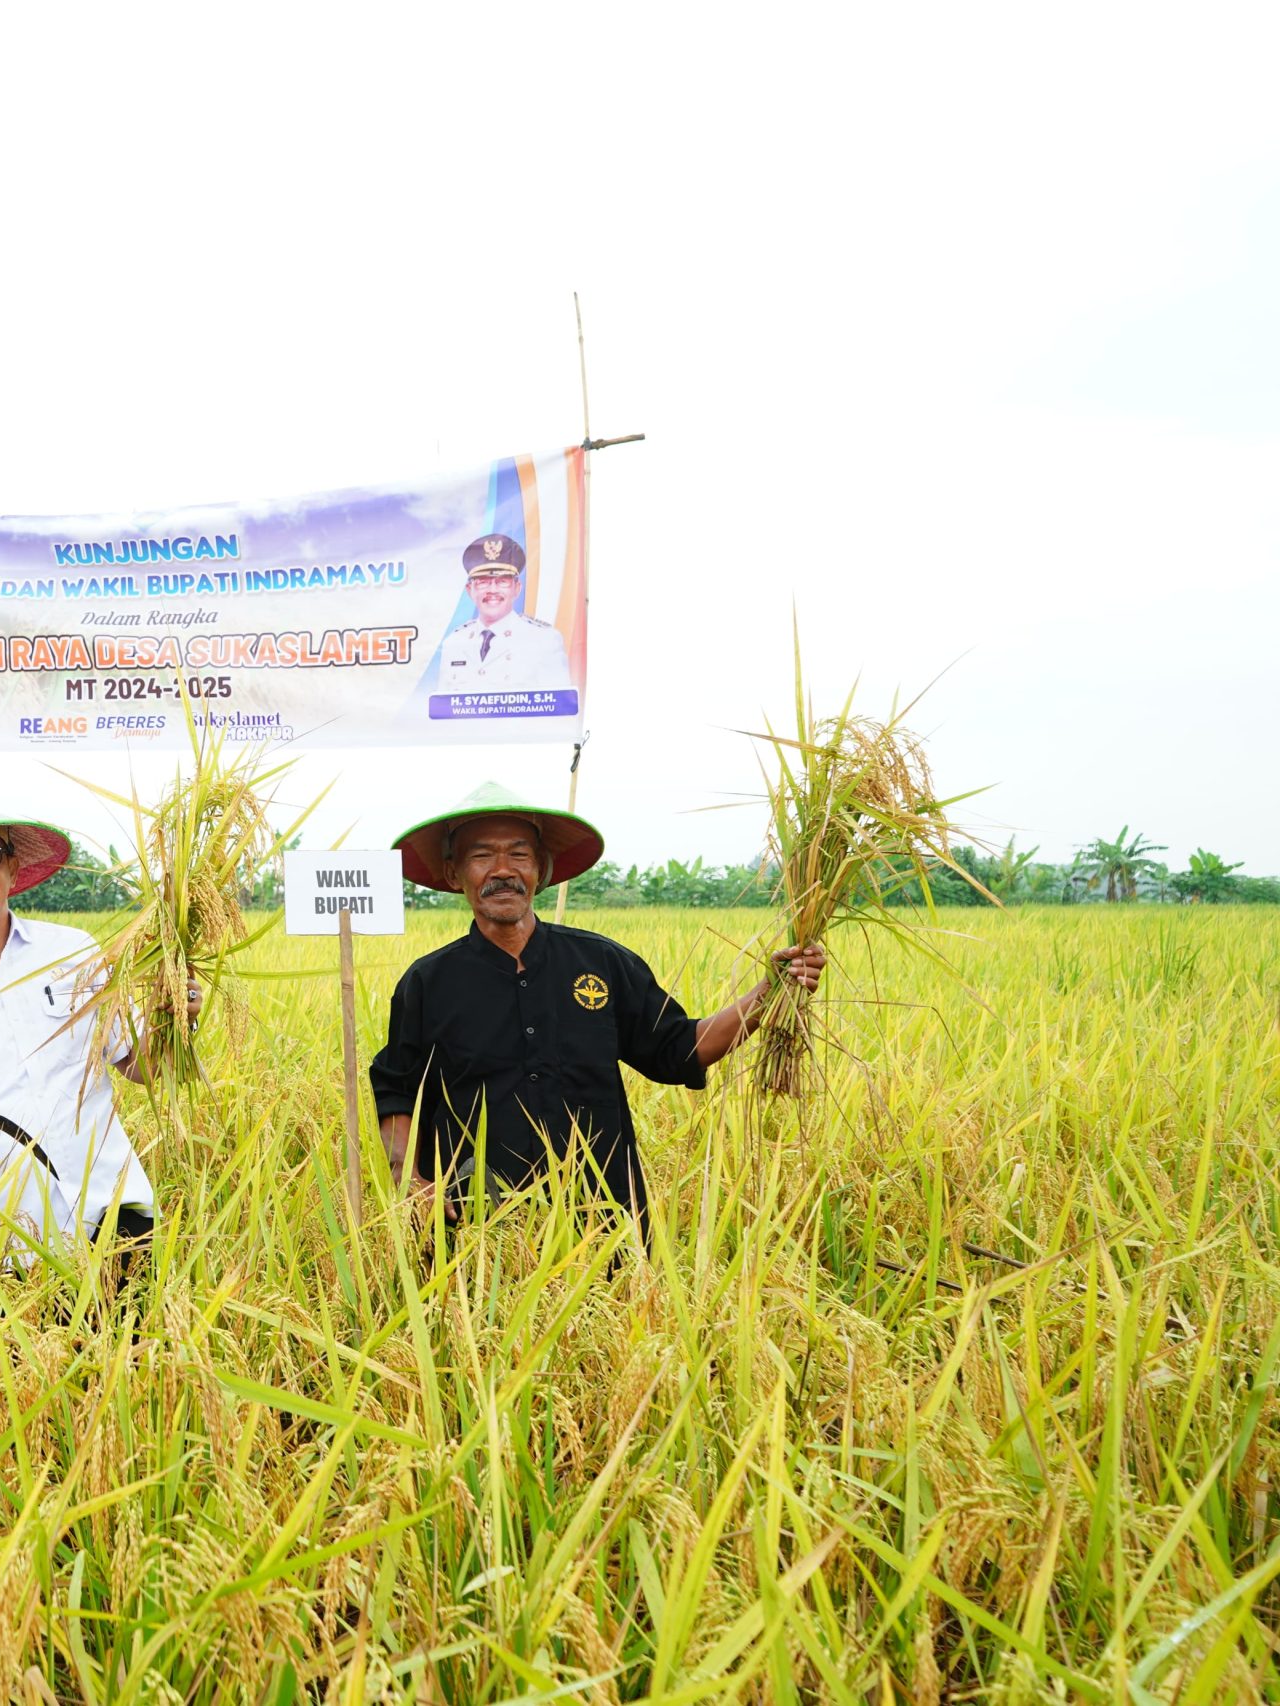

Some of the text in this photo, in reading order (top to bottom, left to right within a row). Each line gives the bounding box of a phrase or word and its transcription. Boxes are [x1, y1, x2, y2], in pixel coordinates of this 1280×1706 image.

[54, 534, 238, 565] KUNJUNGAN
[1, 579, 54, 598] DAN
[62, 576, 139, 598] WAKIL
[147, 572, 238, 596] BUPATI
[245, 562, 405, 591] INDRAMAYU
[81, 608, 219, 629] Dalam Rangka
[10, 636, 90, 671] RAYA
[95, 636, 180, 668] DESA
[187, 628, 416, 668] SUKASLAMET
[66, 676, 232, 700] MT 2024-2025
[451, 693, 556, 706] H. SYAEFUDIN, S.H.
[452, 705, 555, 715] WAKIL BUPATI INDRAMAYU
[20, 717, 87, 734] REANG
[316, 870, 370, 888] WAKIL
[314, 896, 373, 914] BUPATI
